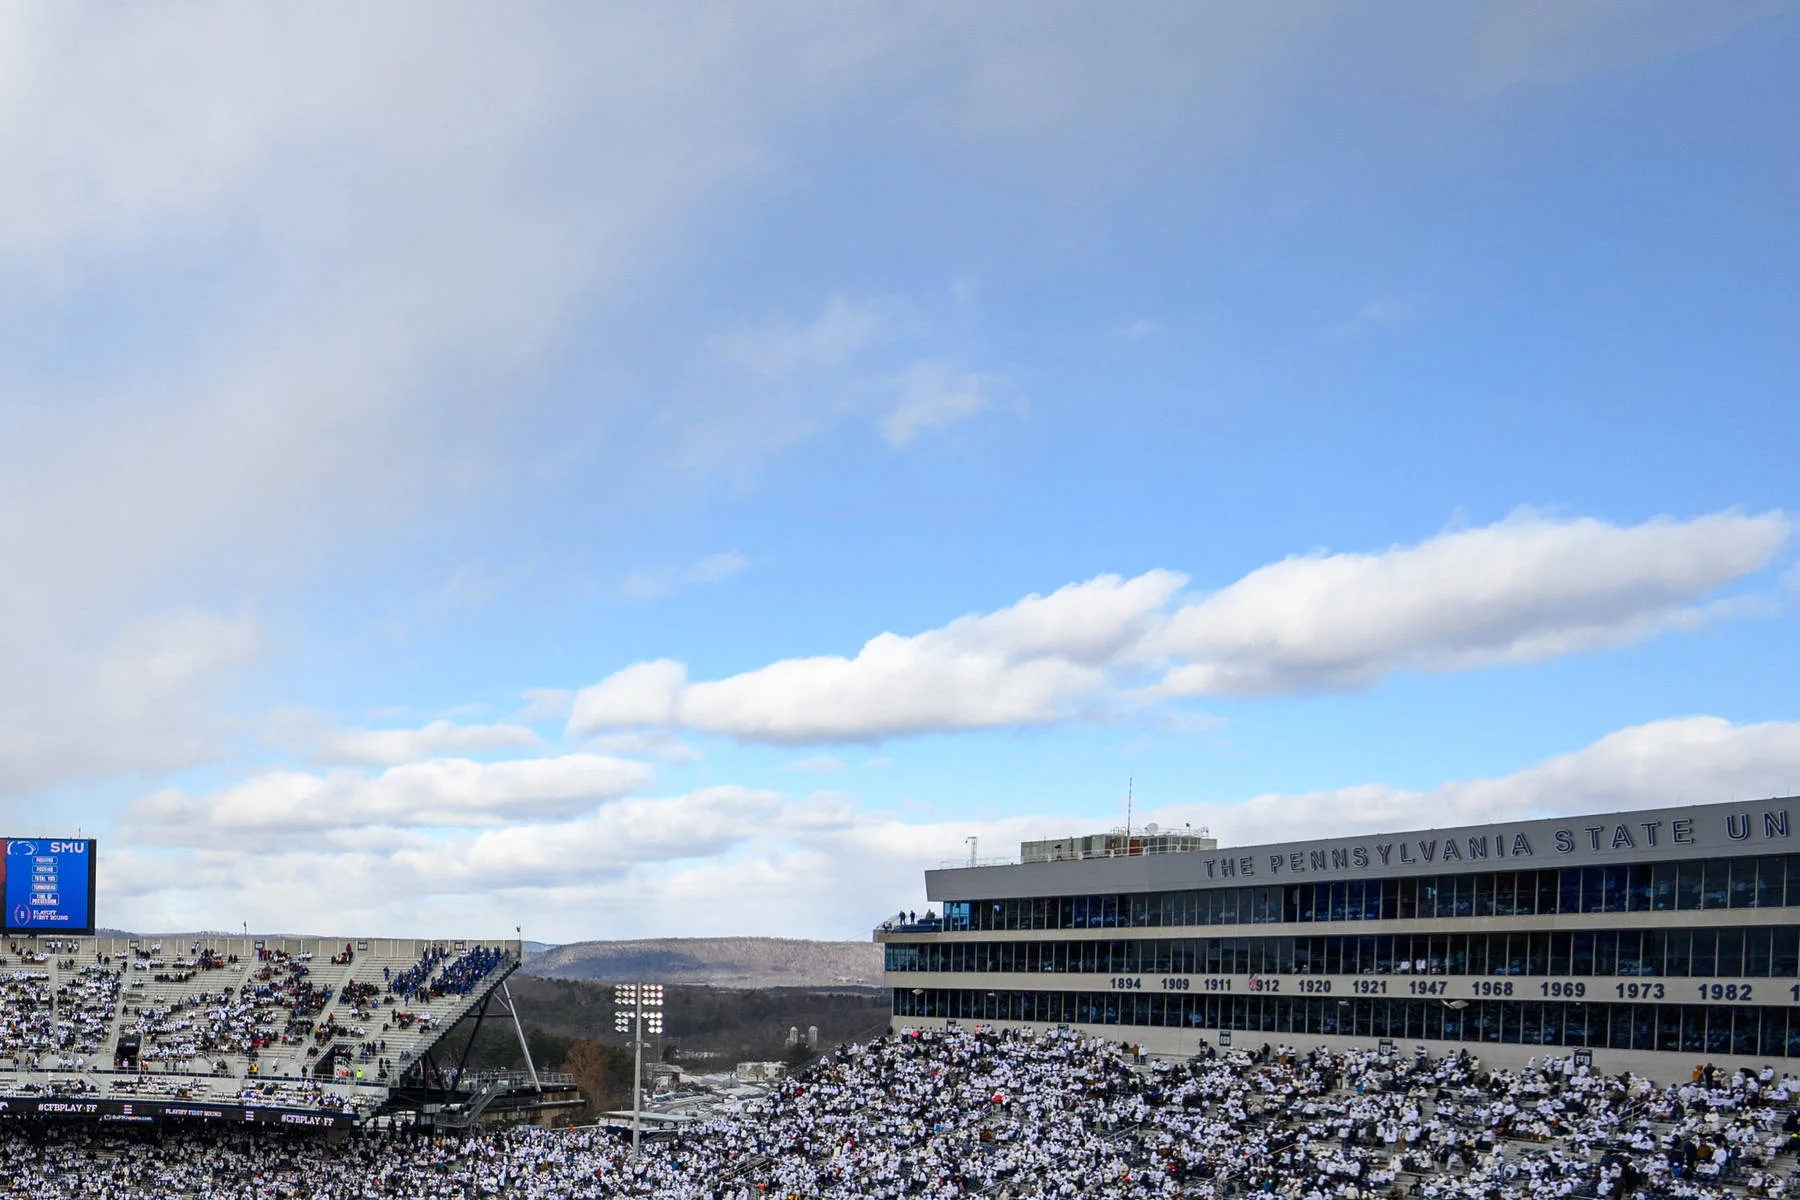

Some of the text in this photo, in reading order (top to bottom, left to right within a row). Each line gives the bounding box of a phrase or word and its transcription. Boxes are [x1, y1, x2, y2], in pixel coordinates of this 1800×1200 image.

[50, 842, 85, 854] SMU
[1203, 810, 1790, 878] THE PENNSYLVANIA STATE UN
[1109, 977, 1142, 990] 1894
[1160, 978, 1190, 990] 1909
[1203, 978, 1232, 991] 1911
[1298, 979, 1332, 993] 1920
[1352, 980, 1388, 994] 1921
[1408, 980, 1448, 995] 1947
[1471, 981, 1514, 996] 1968
[1540, 981, 1586, 997] 1969
[1616, 982, 1665, 999] 1973
[1697, 983, 1753, 1001] 1982
